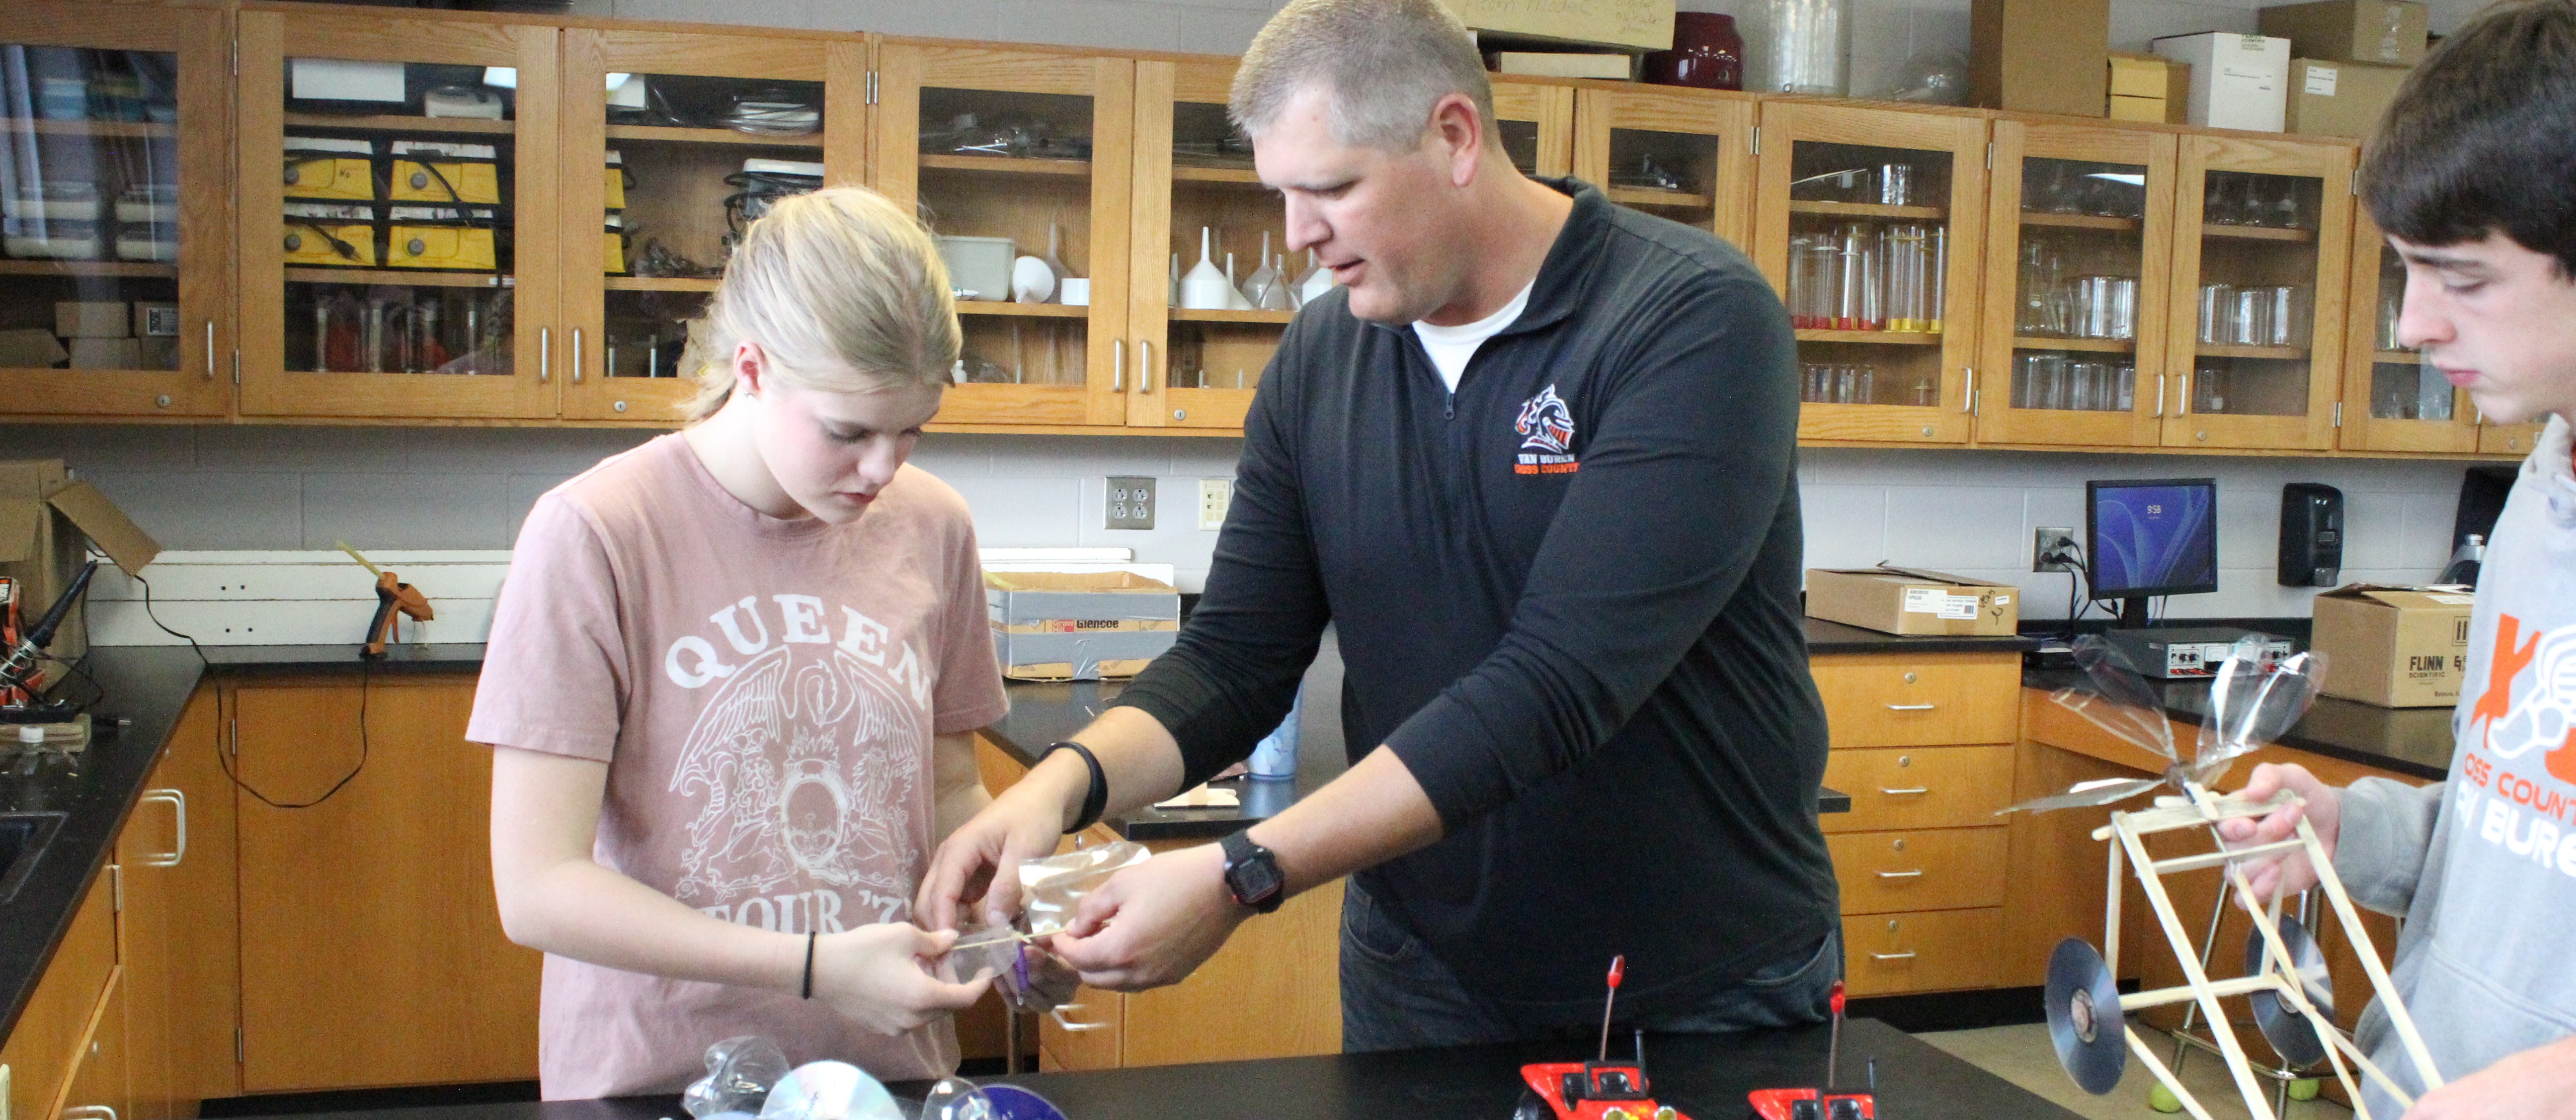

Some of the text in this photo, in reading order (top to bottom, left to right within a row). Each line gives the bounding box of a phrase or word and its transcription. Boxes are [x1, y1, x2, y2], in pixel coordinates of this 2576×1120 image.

[1076, 619, 1119, 628] Glencoe
[665, 594, 930, 711] QUEEN
[2410, 656, 2443, 671] FLINN
